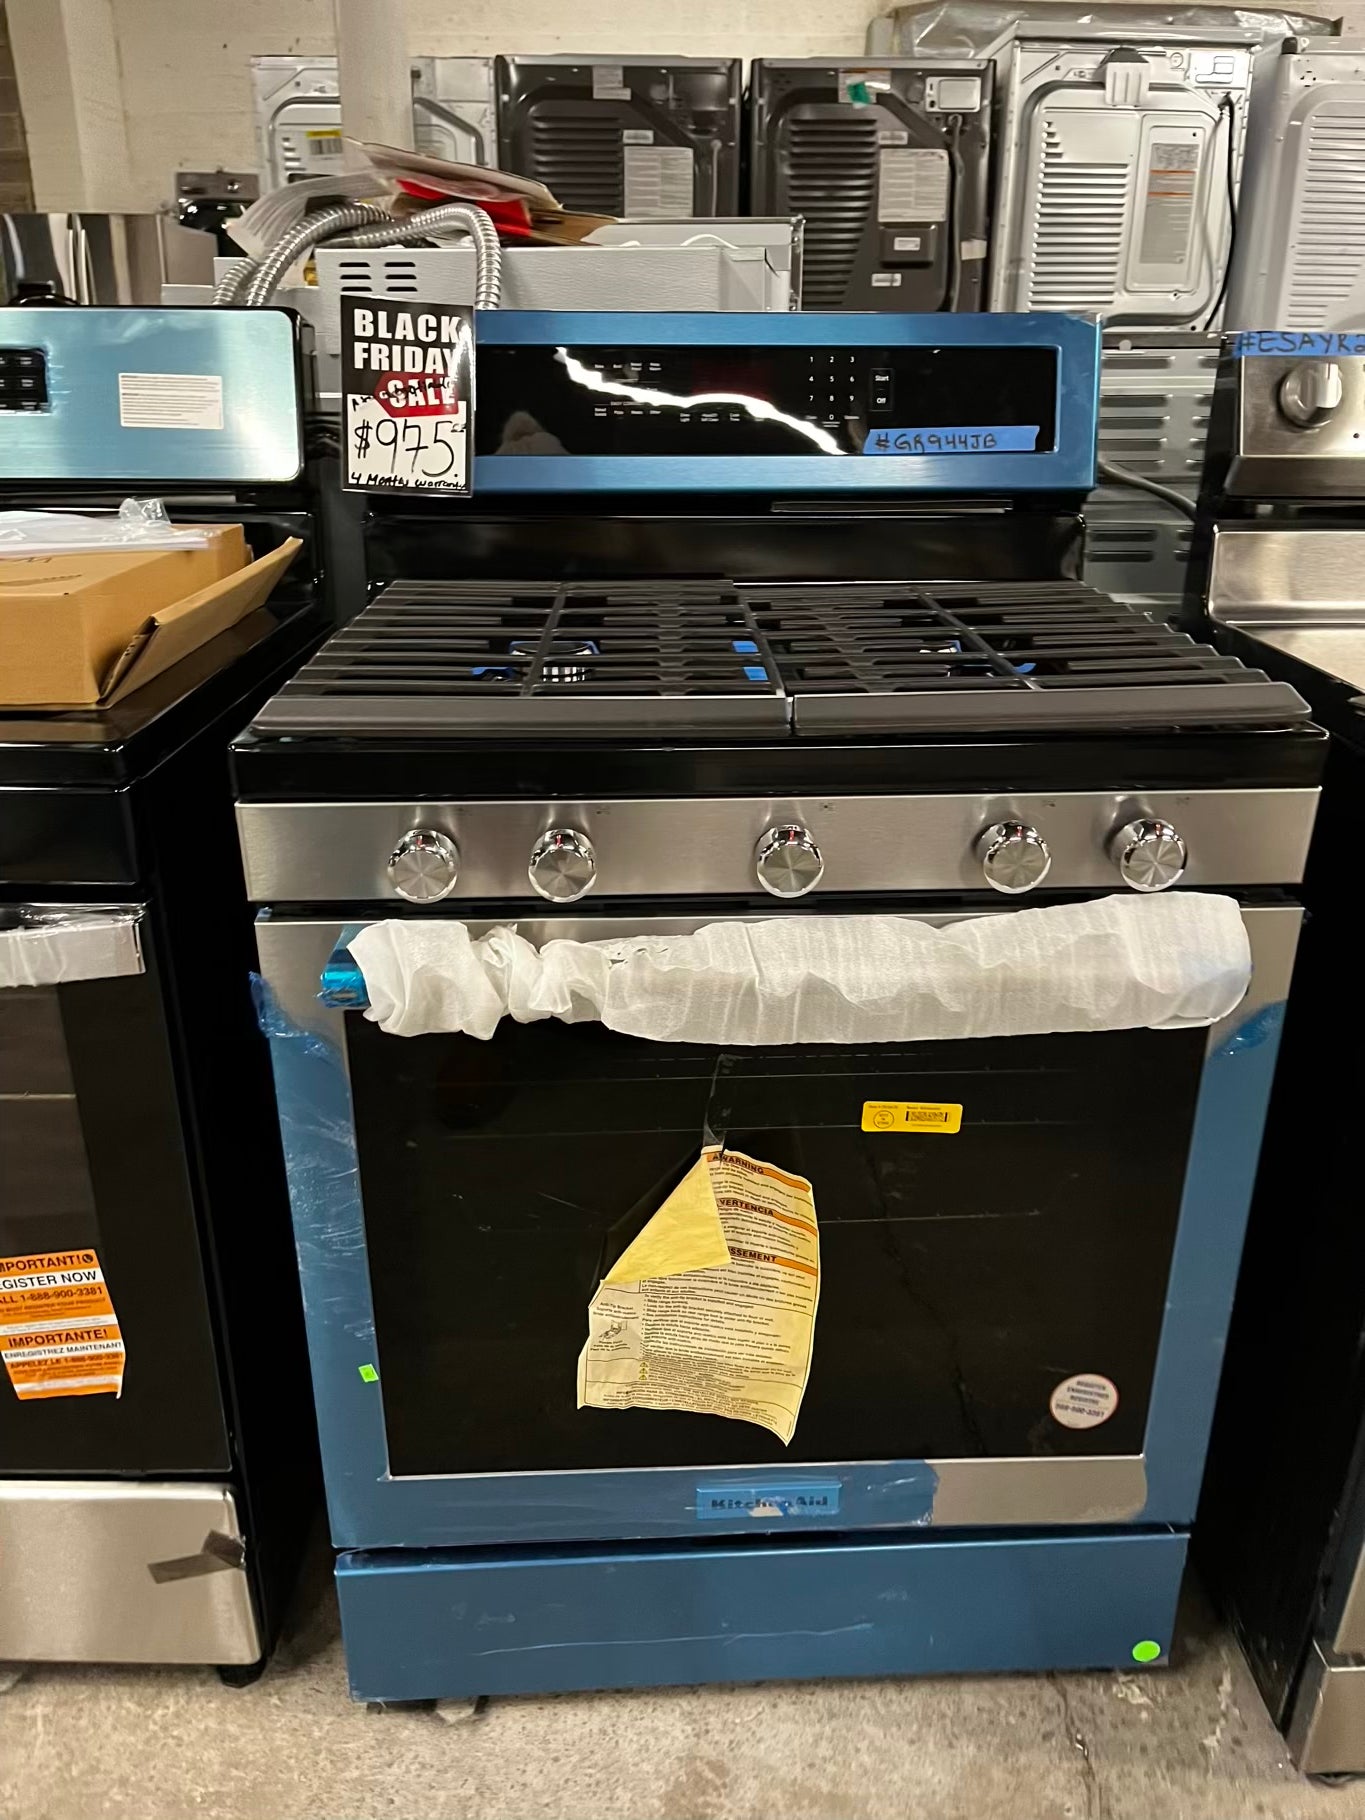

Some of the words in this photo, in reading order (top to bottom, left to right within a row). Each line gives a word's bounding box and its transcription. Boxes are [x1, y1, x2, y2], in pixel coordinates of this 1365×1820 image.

[353, 308, 462, 343] BLACK
[353, 341, 457, 375] FRIDAY
[387, 377, 457, 408] SALE
[875, 432, 998, 453] #GR944JB
[351, 471, 362, 484] 4
[719, 1154, 764, 1175] WARNING
[719, 1199, 774, 1217] VERTENCIA
[729, 1247, 777, 1263] SSEMENT
[61, 1270, 96, 1283] NOW
[20, 1286, 102, 1302] 1-888-900-3381
[8, 1329, 107, 1348] IMPORTANTE!
[4, 1348, 64, 1359] ENREGISTREZ
[66, 1341, 122, 1353] MAINTENANT
[711, 1495, 828, 1509] KitchnAid
